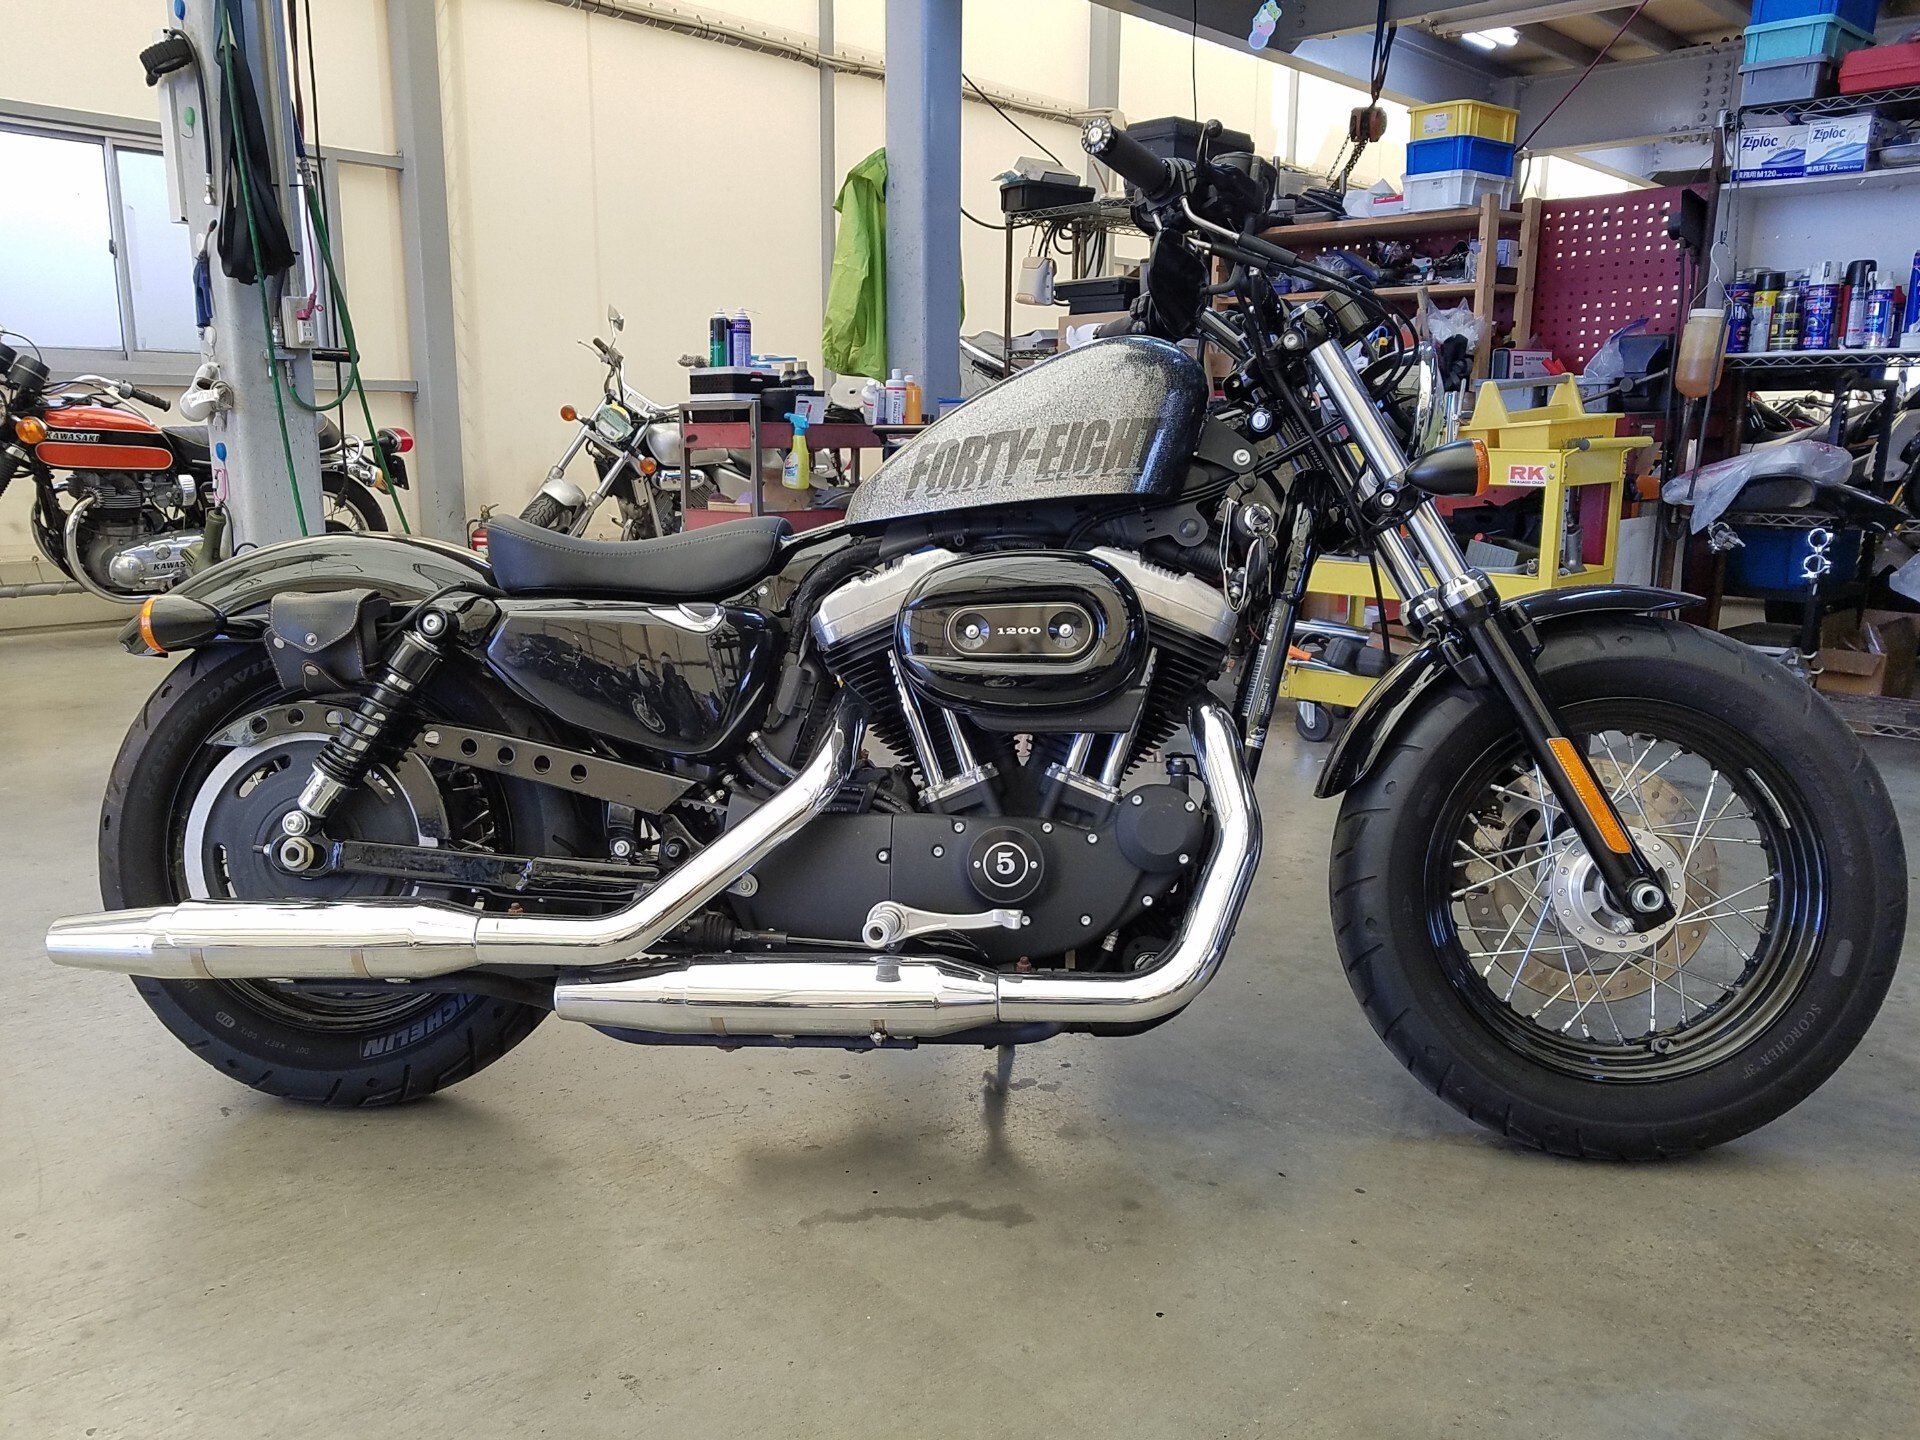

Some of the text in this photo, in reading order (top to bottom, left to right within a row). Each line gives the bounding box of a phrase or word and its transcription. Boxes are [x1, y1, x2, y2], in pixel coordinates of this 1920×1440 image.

[1813, 127, 1847, 143] Ziploc
[1741, 136, 1778, 151] Ziploc
[45, 432, 100, 443] KAWASAKI
[1510, 466, 1545, 480] RK
[153, 561, 188, 571] KAWAS
[996, 626, 1042, 635] 1200
[996, 851, 1016, 875] 5
[1760, 1003, 1822, 1066] SCORCHER
